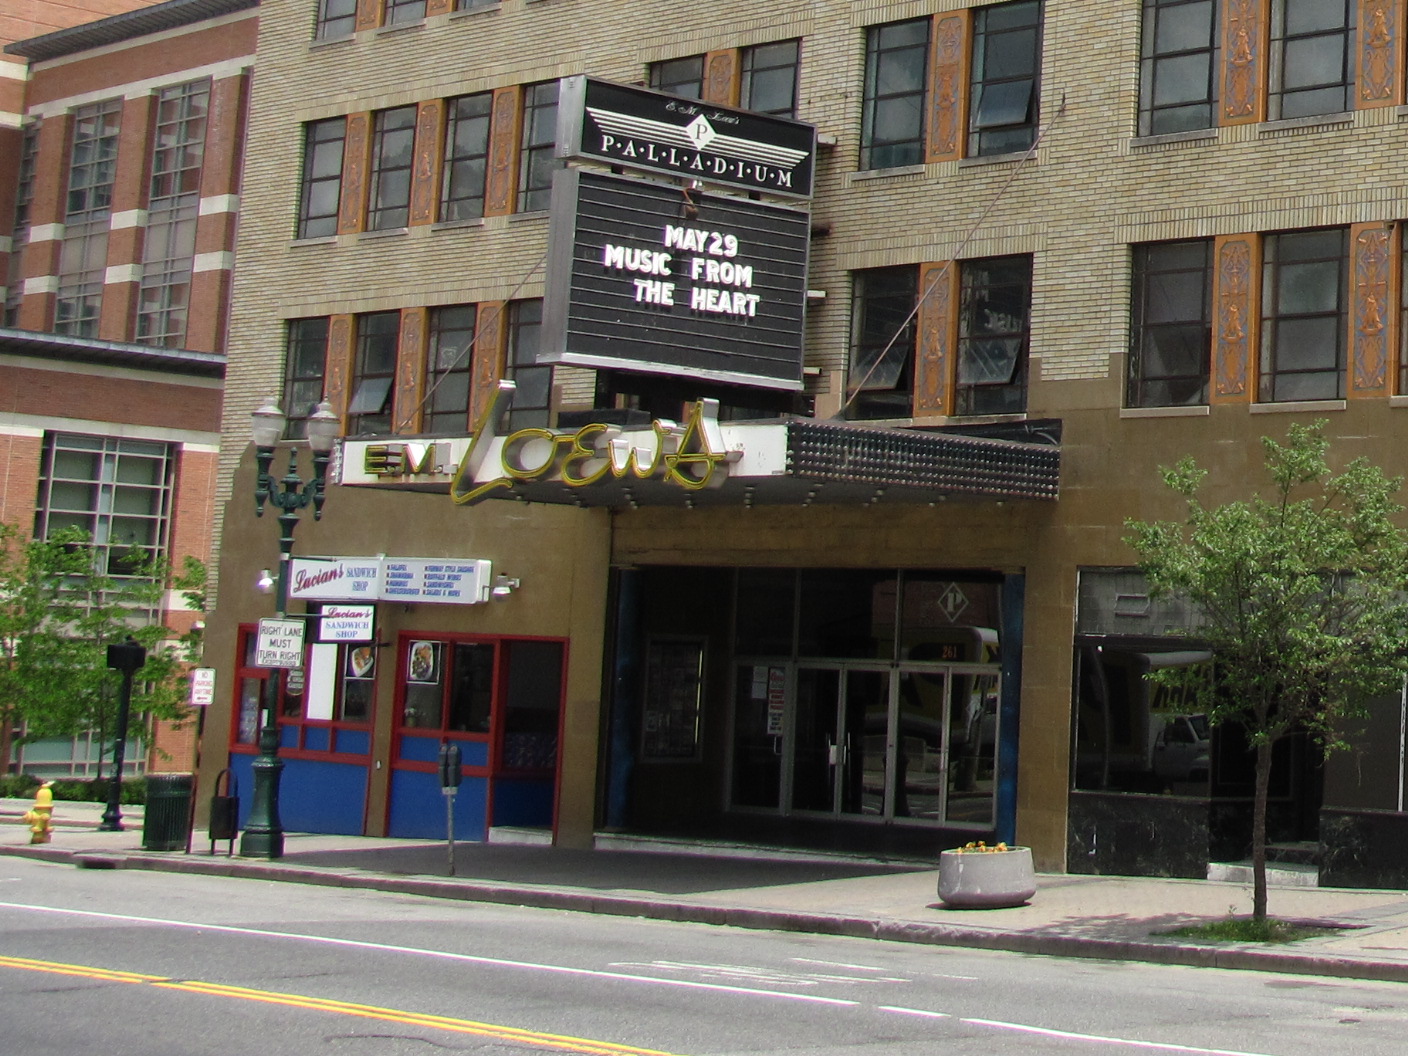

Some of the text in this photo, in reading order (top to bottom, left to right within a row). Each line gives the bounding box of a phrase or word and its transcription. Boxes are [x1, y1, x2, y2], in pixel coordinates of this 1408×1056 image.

[694, 123, 708, 140] P
[604, 243, 753, 288] MUSIC FROM
[633, 278, 761, 317] THE HEART
[352, 580, 369, 592] SHOP
[260, 625, 303, 637] RIGHT LANE
[325, 621, 370, 630] SANDWICH
[335, 630, 358, 638] SHOP
[269, 638, 292, 649] MUST
[259, 649, 301, 661] TURN RIGHT
